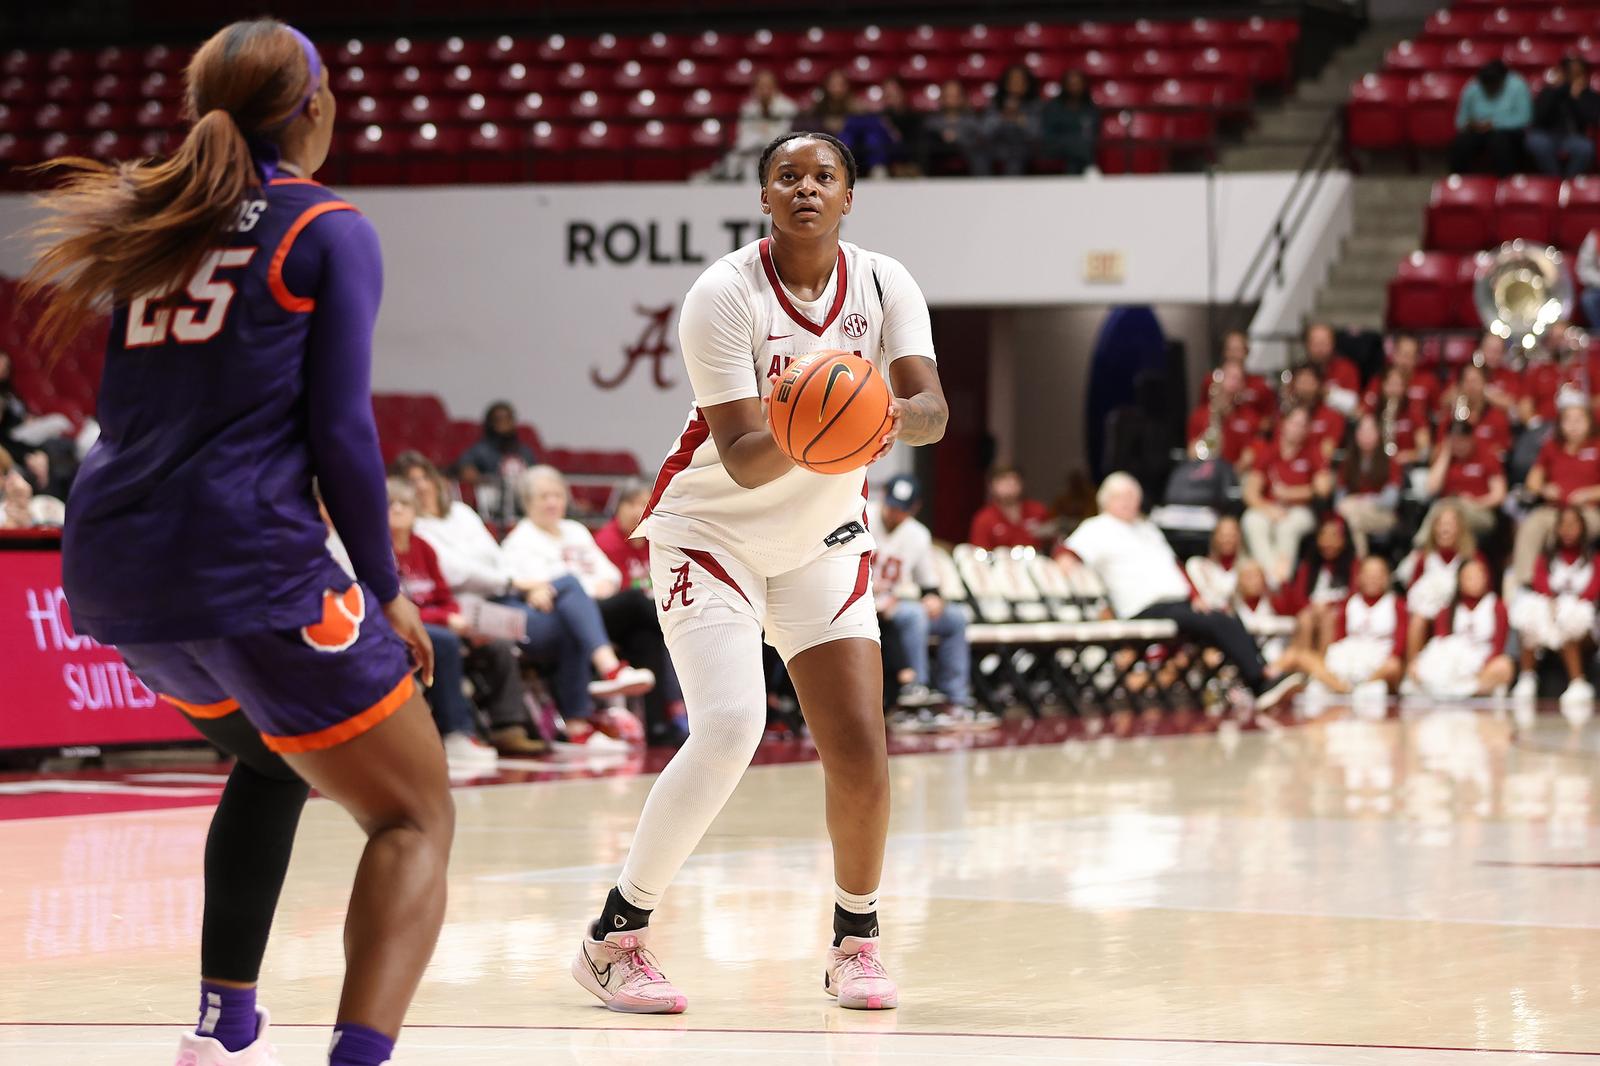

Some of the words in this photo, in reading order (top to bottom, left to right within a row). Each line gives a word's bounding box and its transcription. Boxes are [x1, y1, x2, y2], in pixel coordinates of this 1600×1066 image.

[566, 220, 704, 265] ROLL
[844, 314, 868, 338] SEC
[662, 561, 694, 612] A
[62, 661, 157, 711] SUITES
